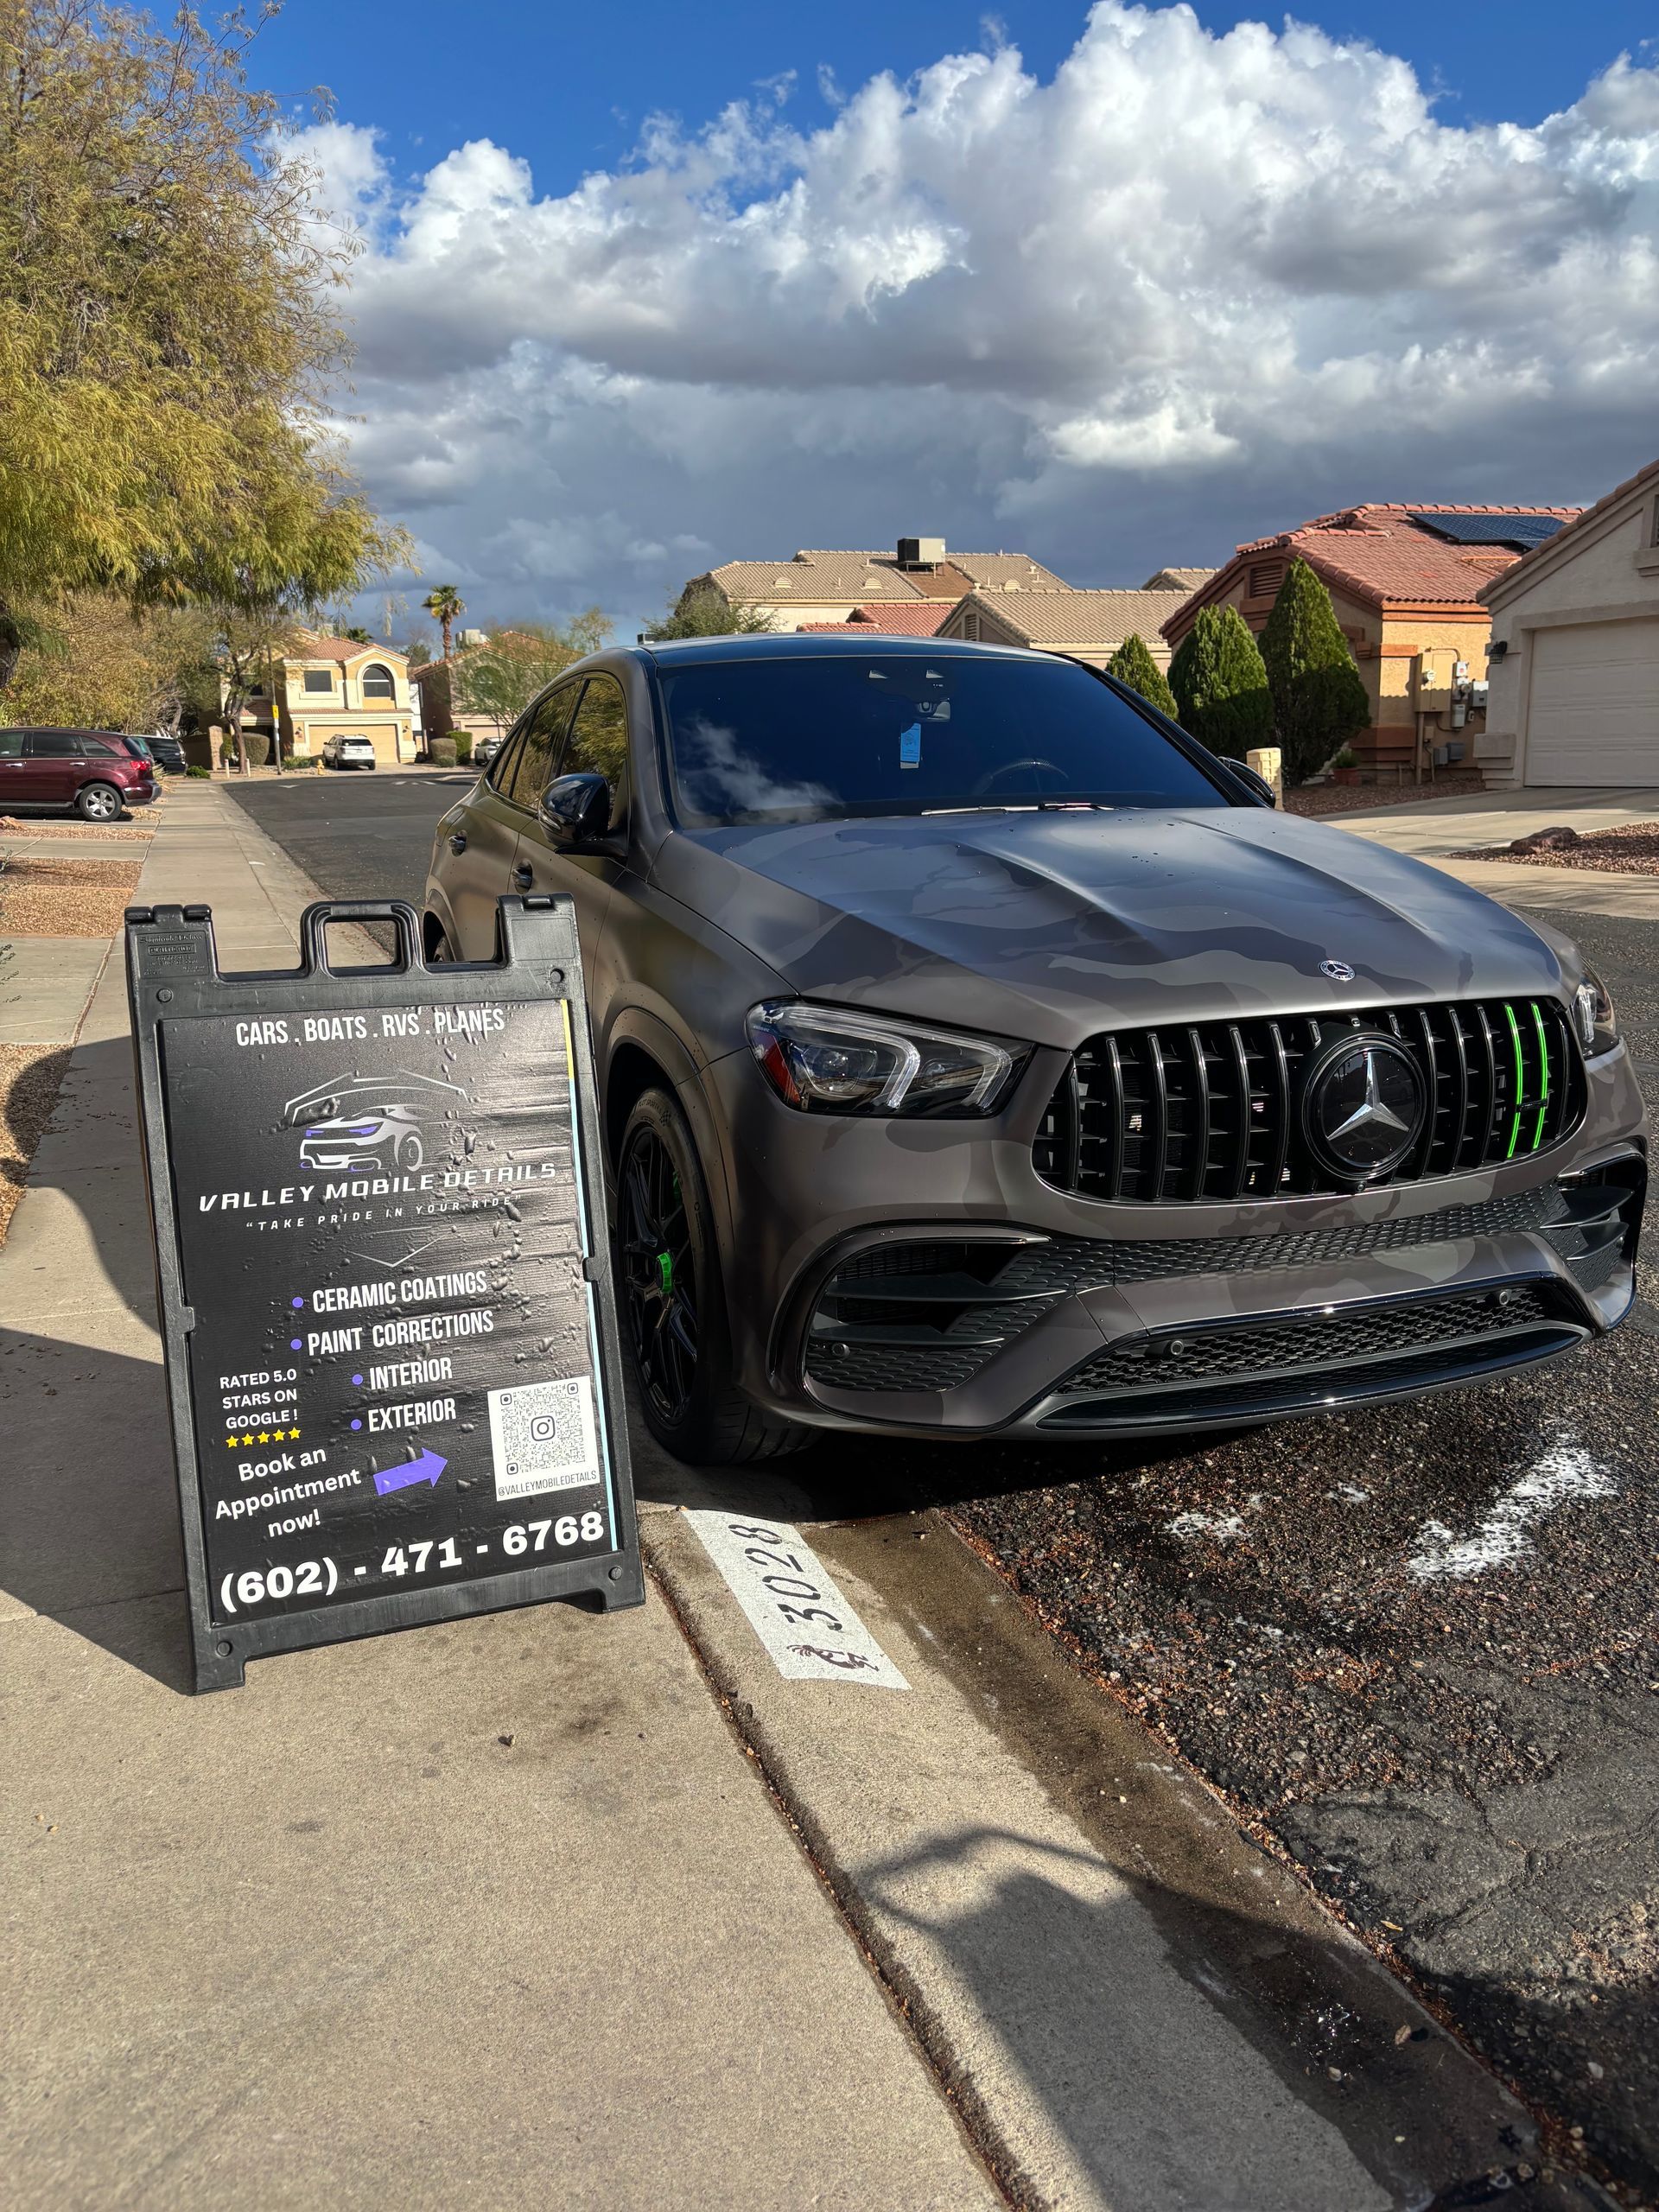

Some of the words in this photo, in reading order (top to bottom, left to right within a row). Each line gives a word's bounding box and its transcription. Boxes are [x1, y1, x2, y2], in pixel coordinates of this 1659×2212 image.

[236, 1020, 289, 1046] CARS
[303, 1016, 367, 1042] BOATS
[382, 1013, 420, 1037] RVS
[434, 1008, 505, 1034] PLANES
[199, 1185, 315, 1212] VALLEY
[325, 1173, 435, 1200] MOBILE
[443, 1162, 556, 1188] DETAILS
[317, 1211, 372, 1225] PRIDE
[385, 1208, 403, 1218] IN
[416, 1202, 460, 1215] YOUR
[312, 1281, 397, 1313] CERAMIC
[400, 1270, 487, 1302] COATINGS
[307, 1327, 363, 1356] PAINT
[372, 1310, 494, 1348] CORRECTIONS
[219, 1371, 270, 1389] RATED
[273, 1368, 297, 1382] 5.0
[369, 1357, 453, 1389] INTERIOR
[222, 1392, 271, 1409] STARS
[274, 1388, 297, 1402] ON
[367, 1398, 456, 1432] EXTERIOR
[226, 1413, 289, 1429] GOOGLE
[238, 1452, 296, 1482] Book
[300, 1448, 327, 1467] an
[215, 1469, 362, 1520] Appointment
[498, 1470, 597, 1497] @VALLEYMOBILEDETAILS
[268, 1509, 321, 1537] now!
[219, 1558, 339, 1613] (602)
[381, 1537, 462, 1577] 471
[502, 1510, 604, 1555] 6768
[728, 1523, 843, 1631] 3028
